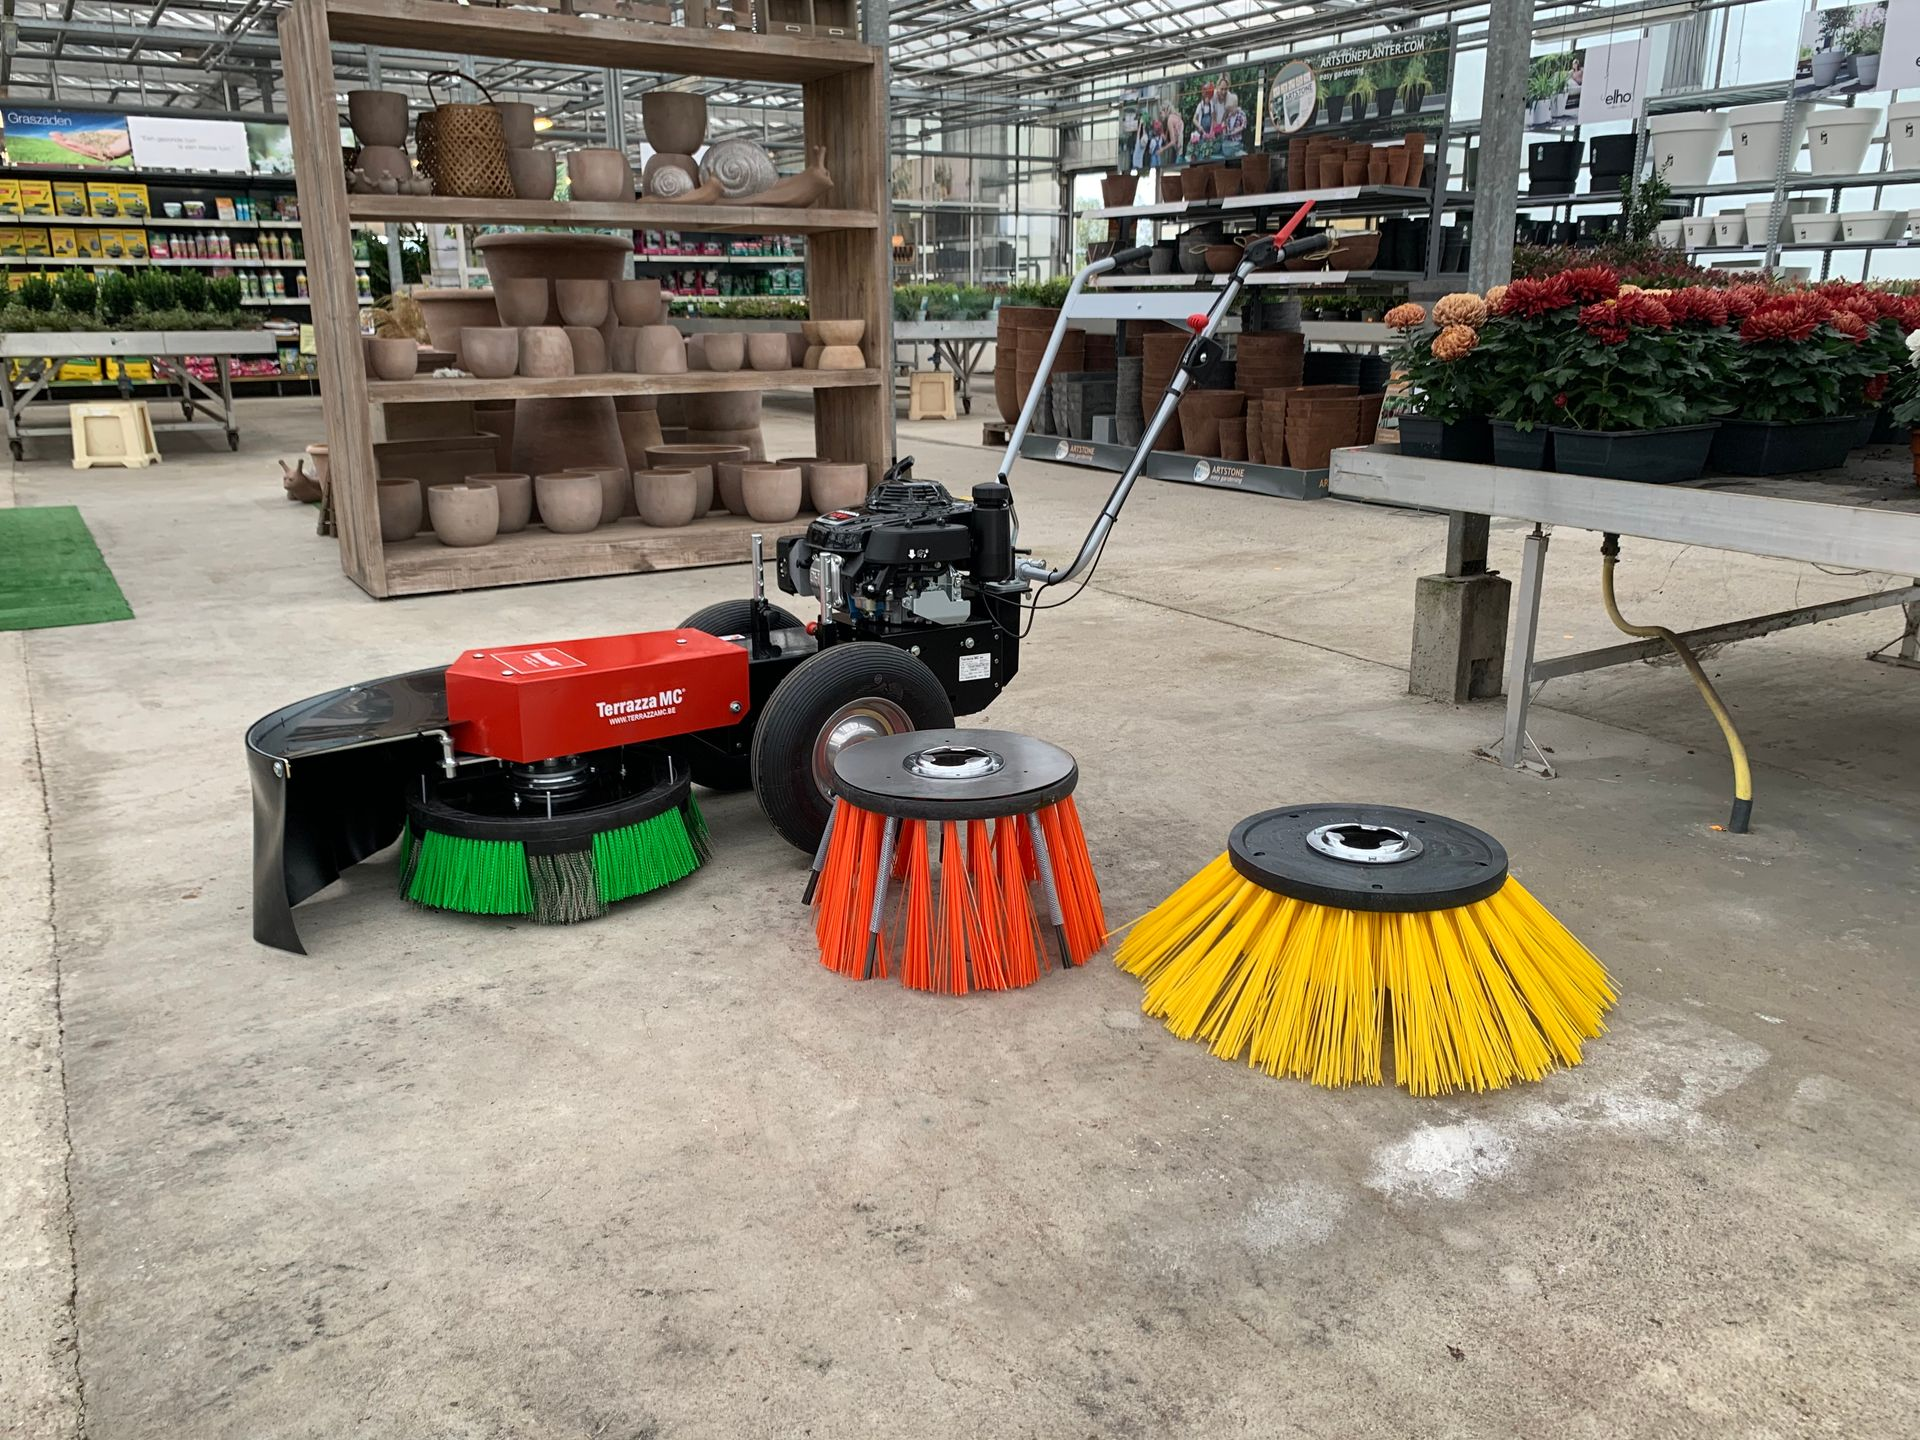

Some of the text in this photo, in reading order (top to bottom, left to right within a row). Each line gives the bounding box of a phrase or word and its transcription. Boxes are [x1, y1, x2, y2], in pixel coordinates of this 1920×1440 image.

[1320, 39, 1425, 68] ARTSTONEPLANTER.COM
[1319, 67, 1364, 81] easy gardening
[1285, 82, 1313, 100] ARTSTONE
[1605, 89, 1632, 105] elho
[7, 112, 72, 126] Graszaden
[1211, 465, 1245, 478] ARTSTONE
[596, 696, 657, 718] Terrazza
[609, 707, 676, 726] WWW.TERRAZZAMC.BE
